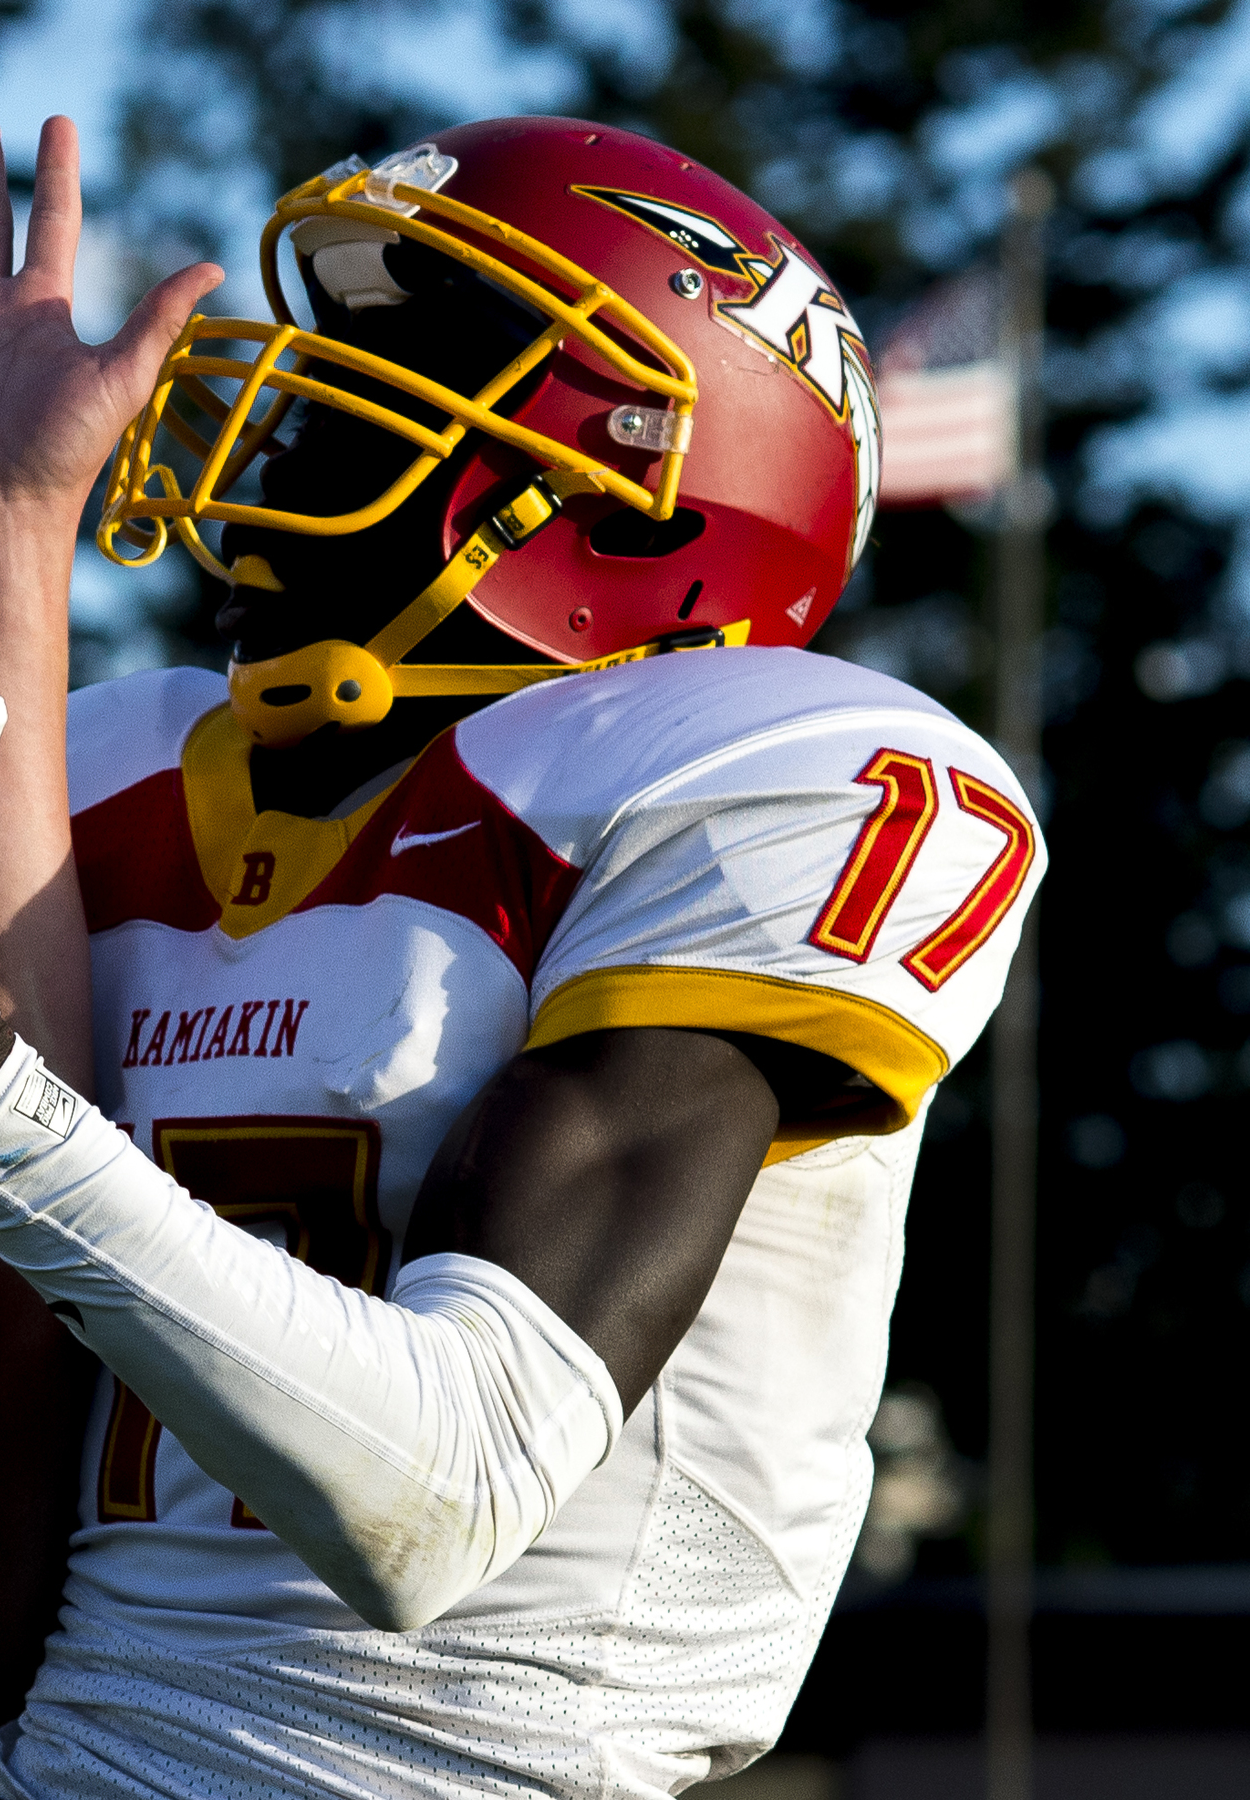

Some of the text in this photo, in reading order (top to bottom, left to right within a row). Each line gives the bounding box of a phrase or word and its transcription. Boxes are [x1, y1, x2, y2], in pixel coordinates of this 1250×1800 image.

[714, 232, 868, 424] K
[230, 851, 275, 907] B
[808, 747, 1035, 992] 17
[123, 998, 310, 1069] KAMIAKIN
